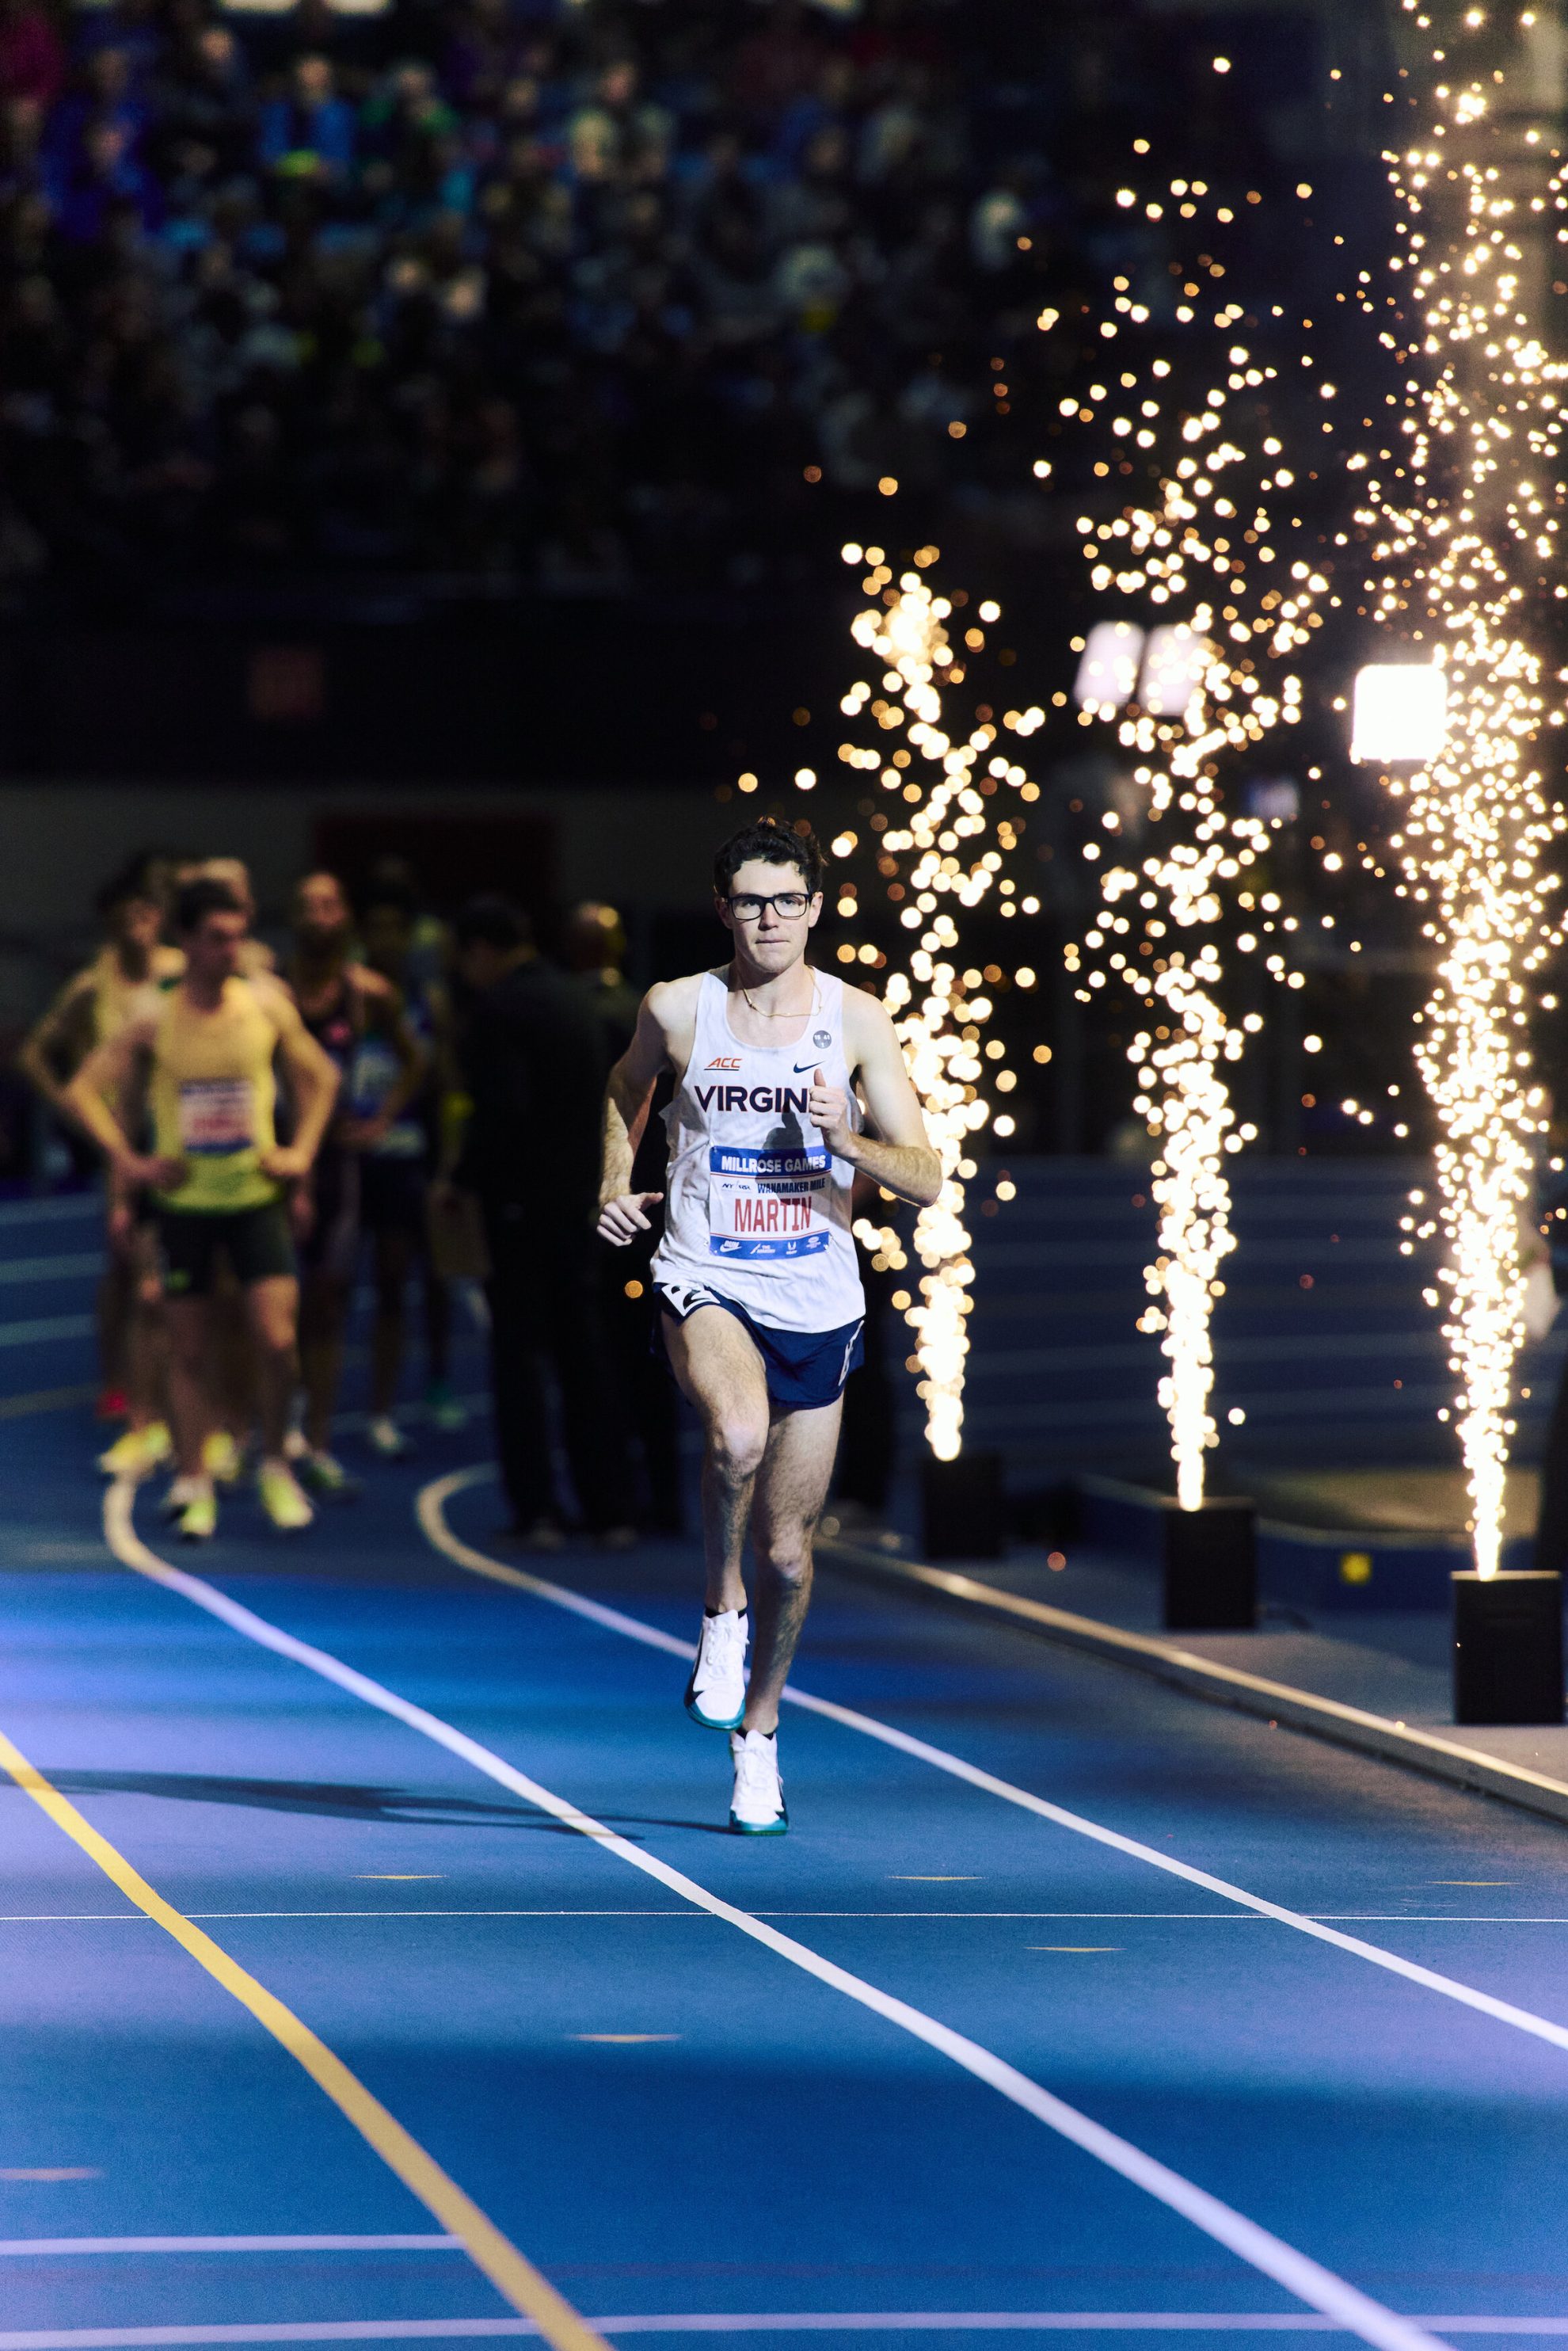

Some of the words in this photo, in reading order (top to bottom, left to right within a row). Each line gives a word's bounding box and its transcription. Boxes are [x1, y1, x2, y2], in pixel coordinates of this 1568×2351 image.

[707, 1057, 743, 1069] ACC
[694, 1085, 811, 1114] VIRGIN
[721, 1156, 782, 1173] MILLROSE
[785, 1155, 826, 1172] GAMES
[757, 1182, 809, 1194] WANAMAKER
[810, 1178, 826, 1191] MILE
[735, 1196, 812, 1233] MARTIN
